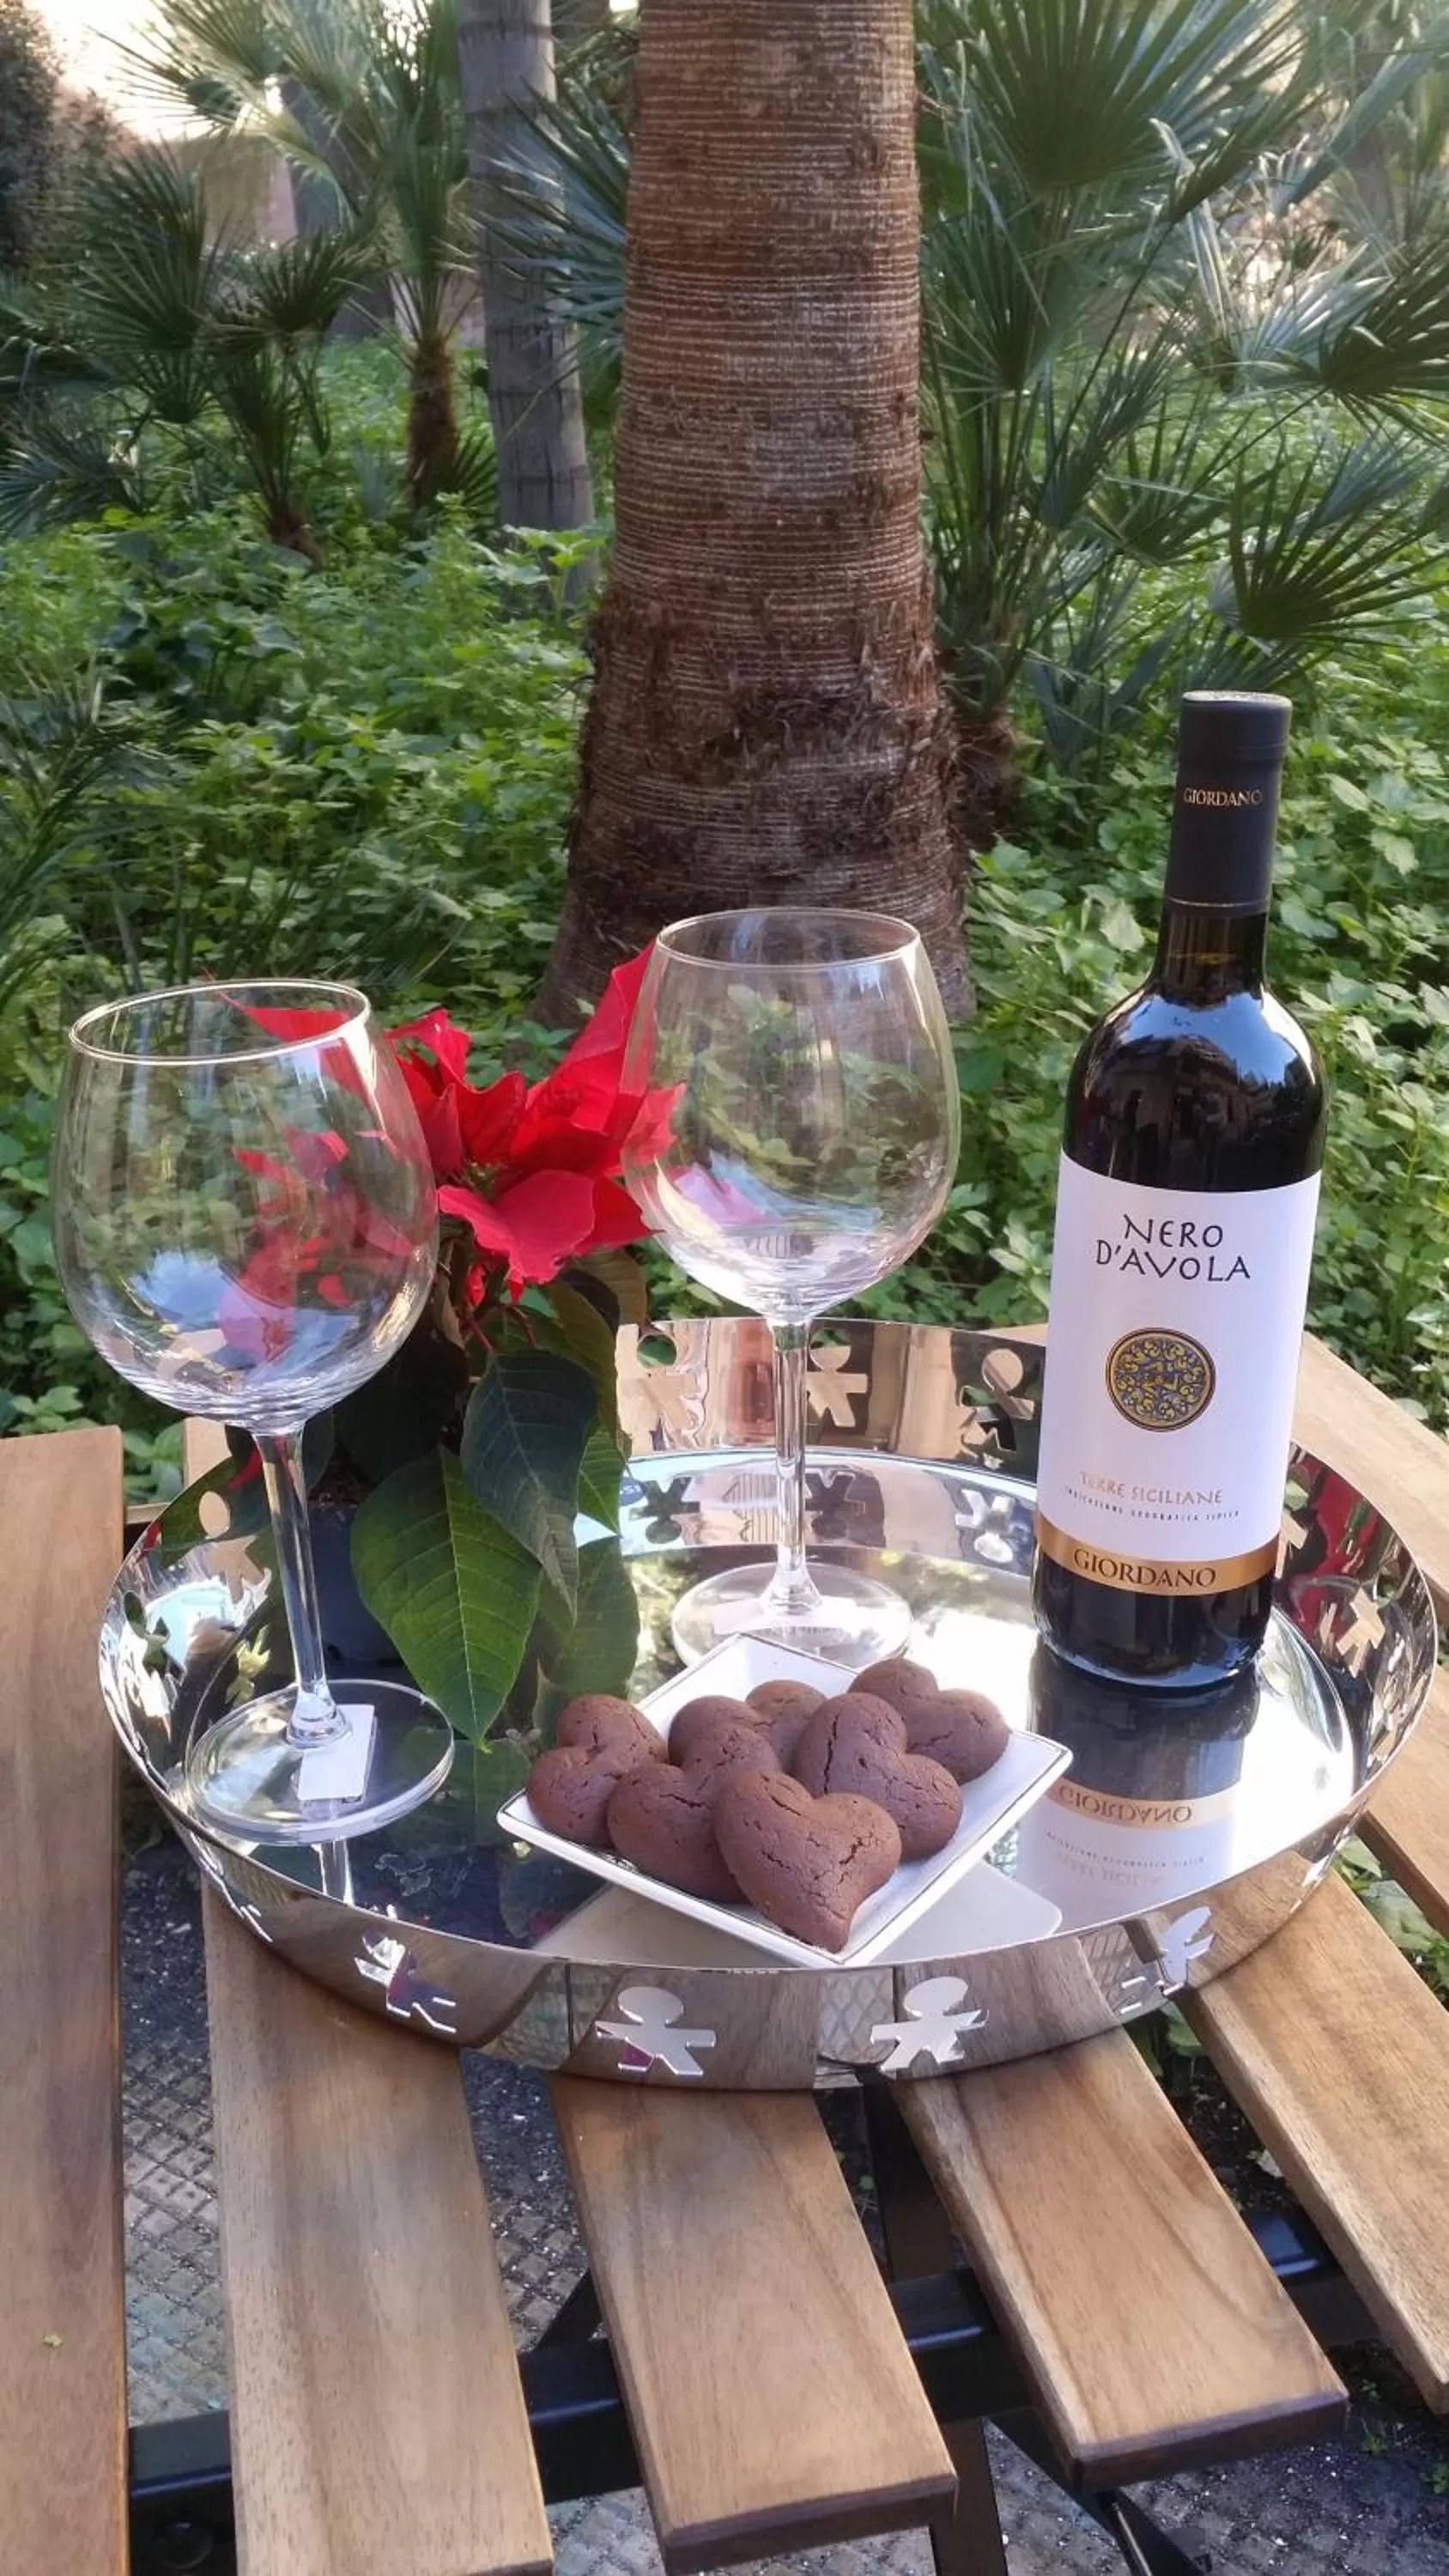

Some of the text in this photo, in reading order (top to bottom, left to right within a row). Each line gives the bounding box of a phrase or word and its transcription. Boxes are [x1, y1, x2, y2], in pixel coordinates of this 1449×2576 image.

[1184, 787, 1263, 805] GIORDANO
[1123, 1213, 1223, 1248] NERO
[1096, 1239, 1251, 1282] D'AVOLA
[1131, 1485, 1223, 1505] SICILIANE
[1074, 1548, 1216, 1588] GIORDANO
